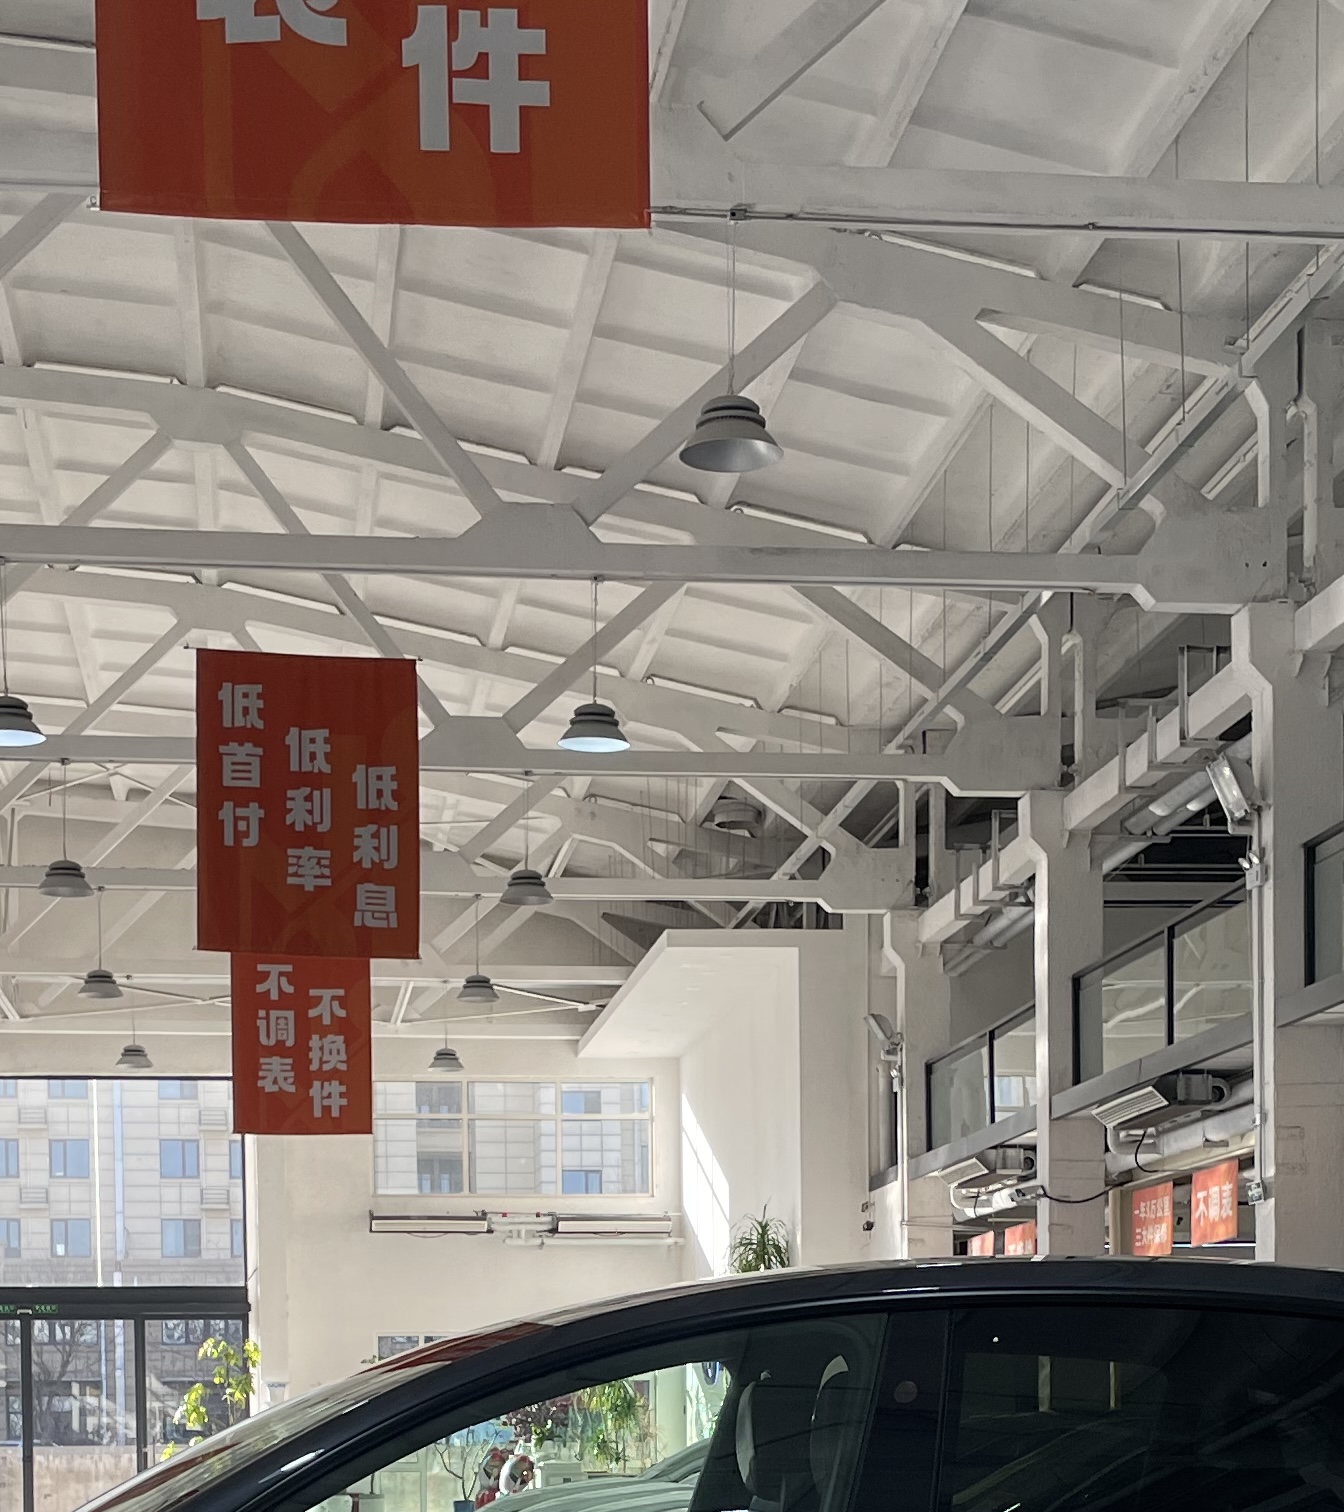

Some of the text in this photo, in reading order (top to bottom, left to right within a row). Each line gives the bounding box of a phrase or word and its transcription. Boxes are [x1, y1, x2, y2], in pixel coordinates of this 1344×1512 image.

[402, 4, 551, 154] 件
[217, 682, 265, 848] 低首付
[284, 726, 332, 892] 低利率
[351, 764, 399, 929] 低利息
[255, 963, 297, 1094] 不调表
[307, 988, 348, 1119] 不换件
